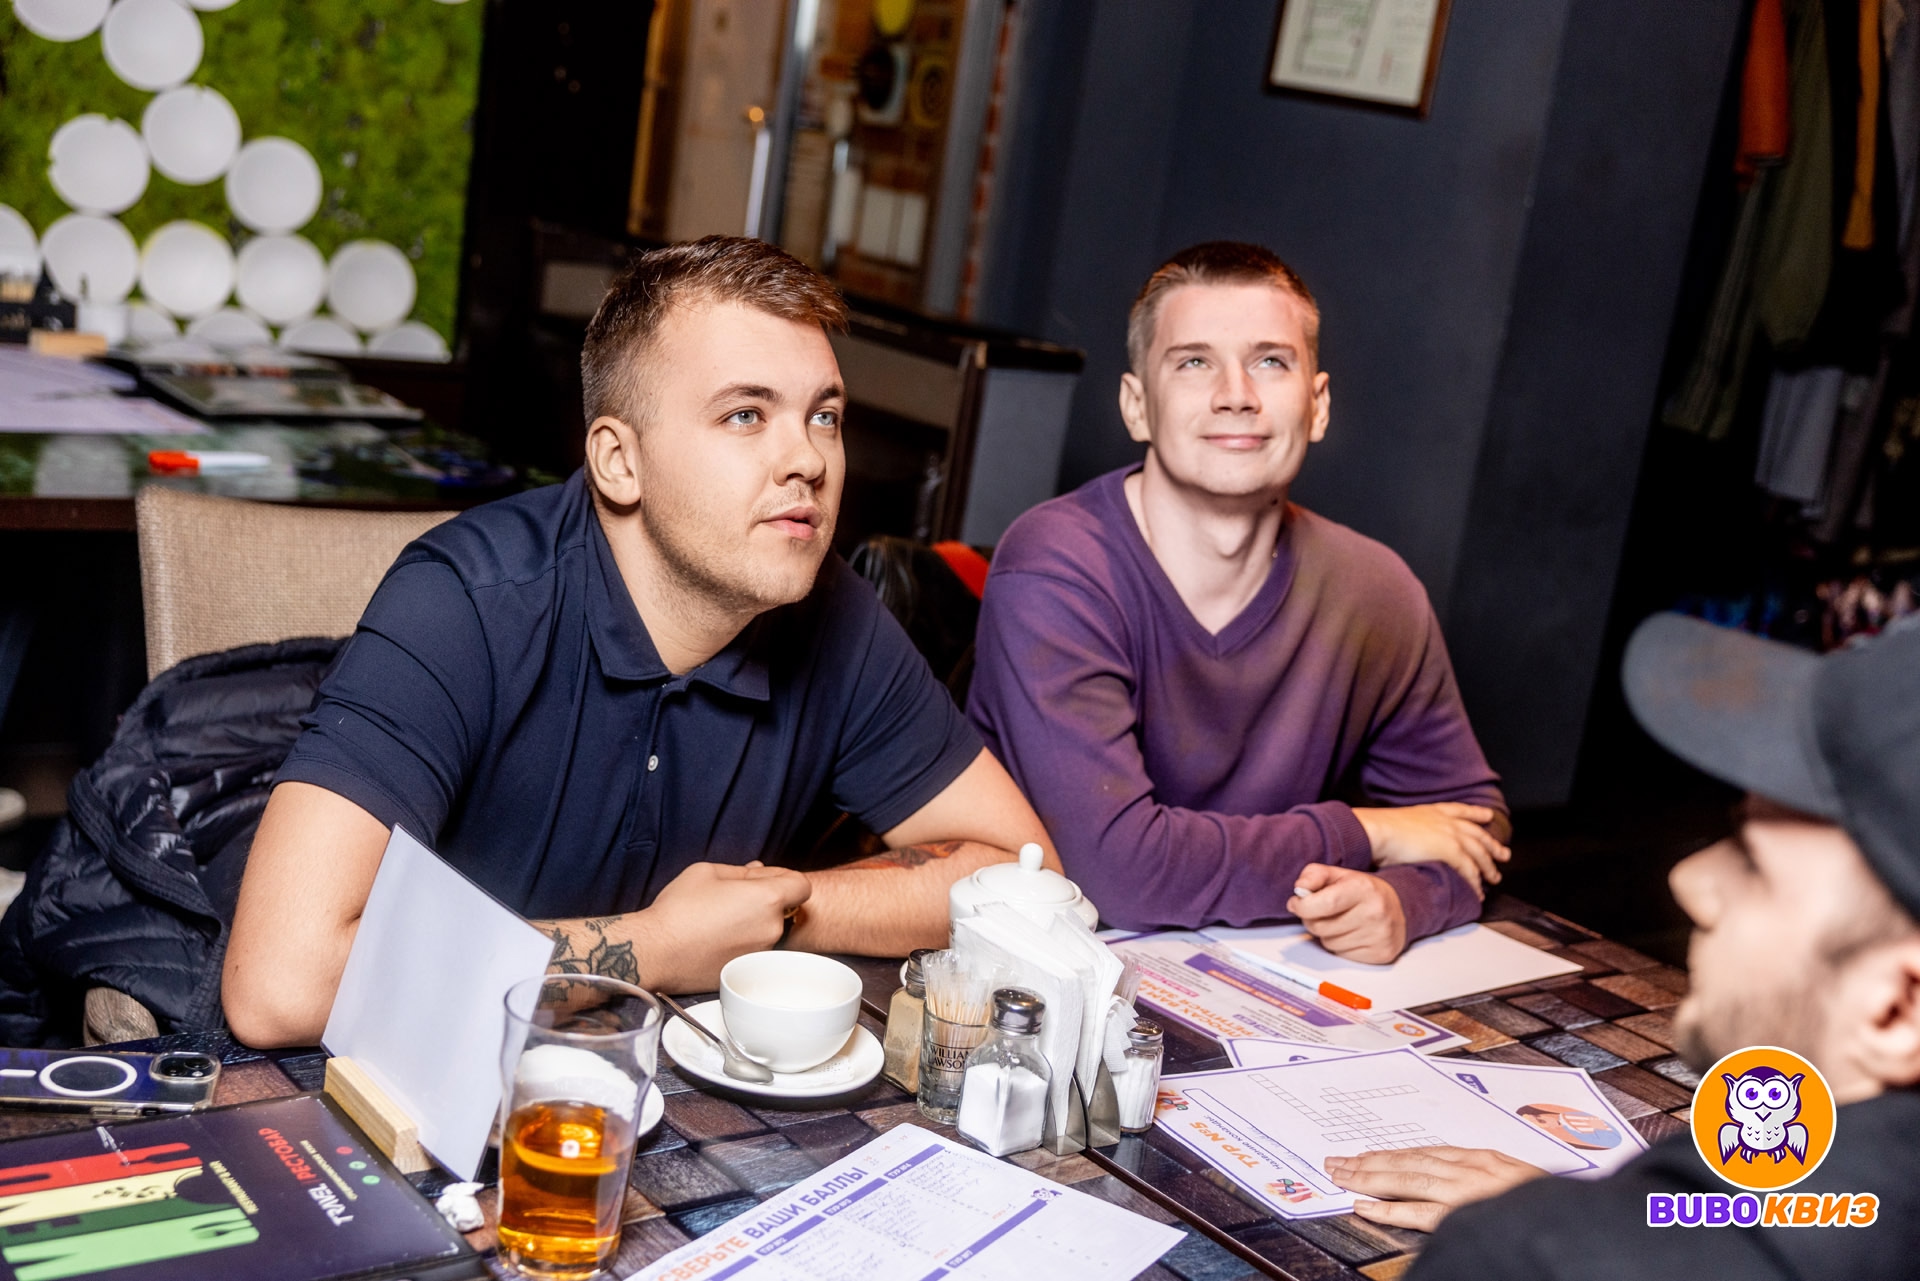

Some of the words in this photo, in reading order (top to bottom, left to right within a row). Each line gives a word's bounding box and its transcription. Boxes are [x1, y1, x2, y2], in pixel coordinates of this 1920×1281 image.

[927, 1053, 966, 1069] LAWSO
[1189, 1122, 1225, 1142] №5
[258, 1127, 317, 1181] РЕСТОБАР
[1221, 1144, 1259, 1168] ТУР
[308, 1182, 354, 1227] TRAVEL
[743, 1203, 807, 1240] ВАШИ
[800, 1166, 868, 1206] БАЛЛЫ
